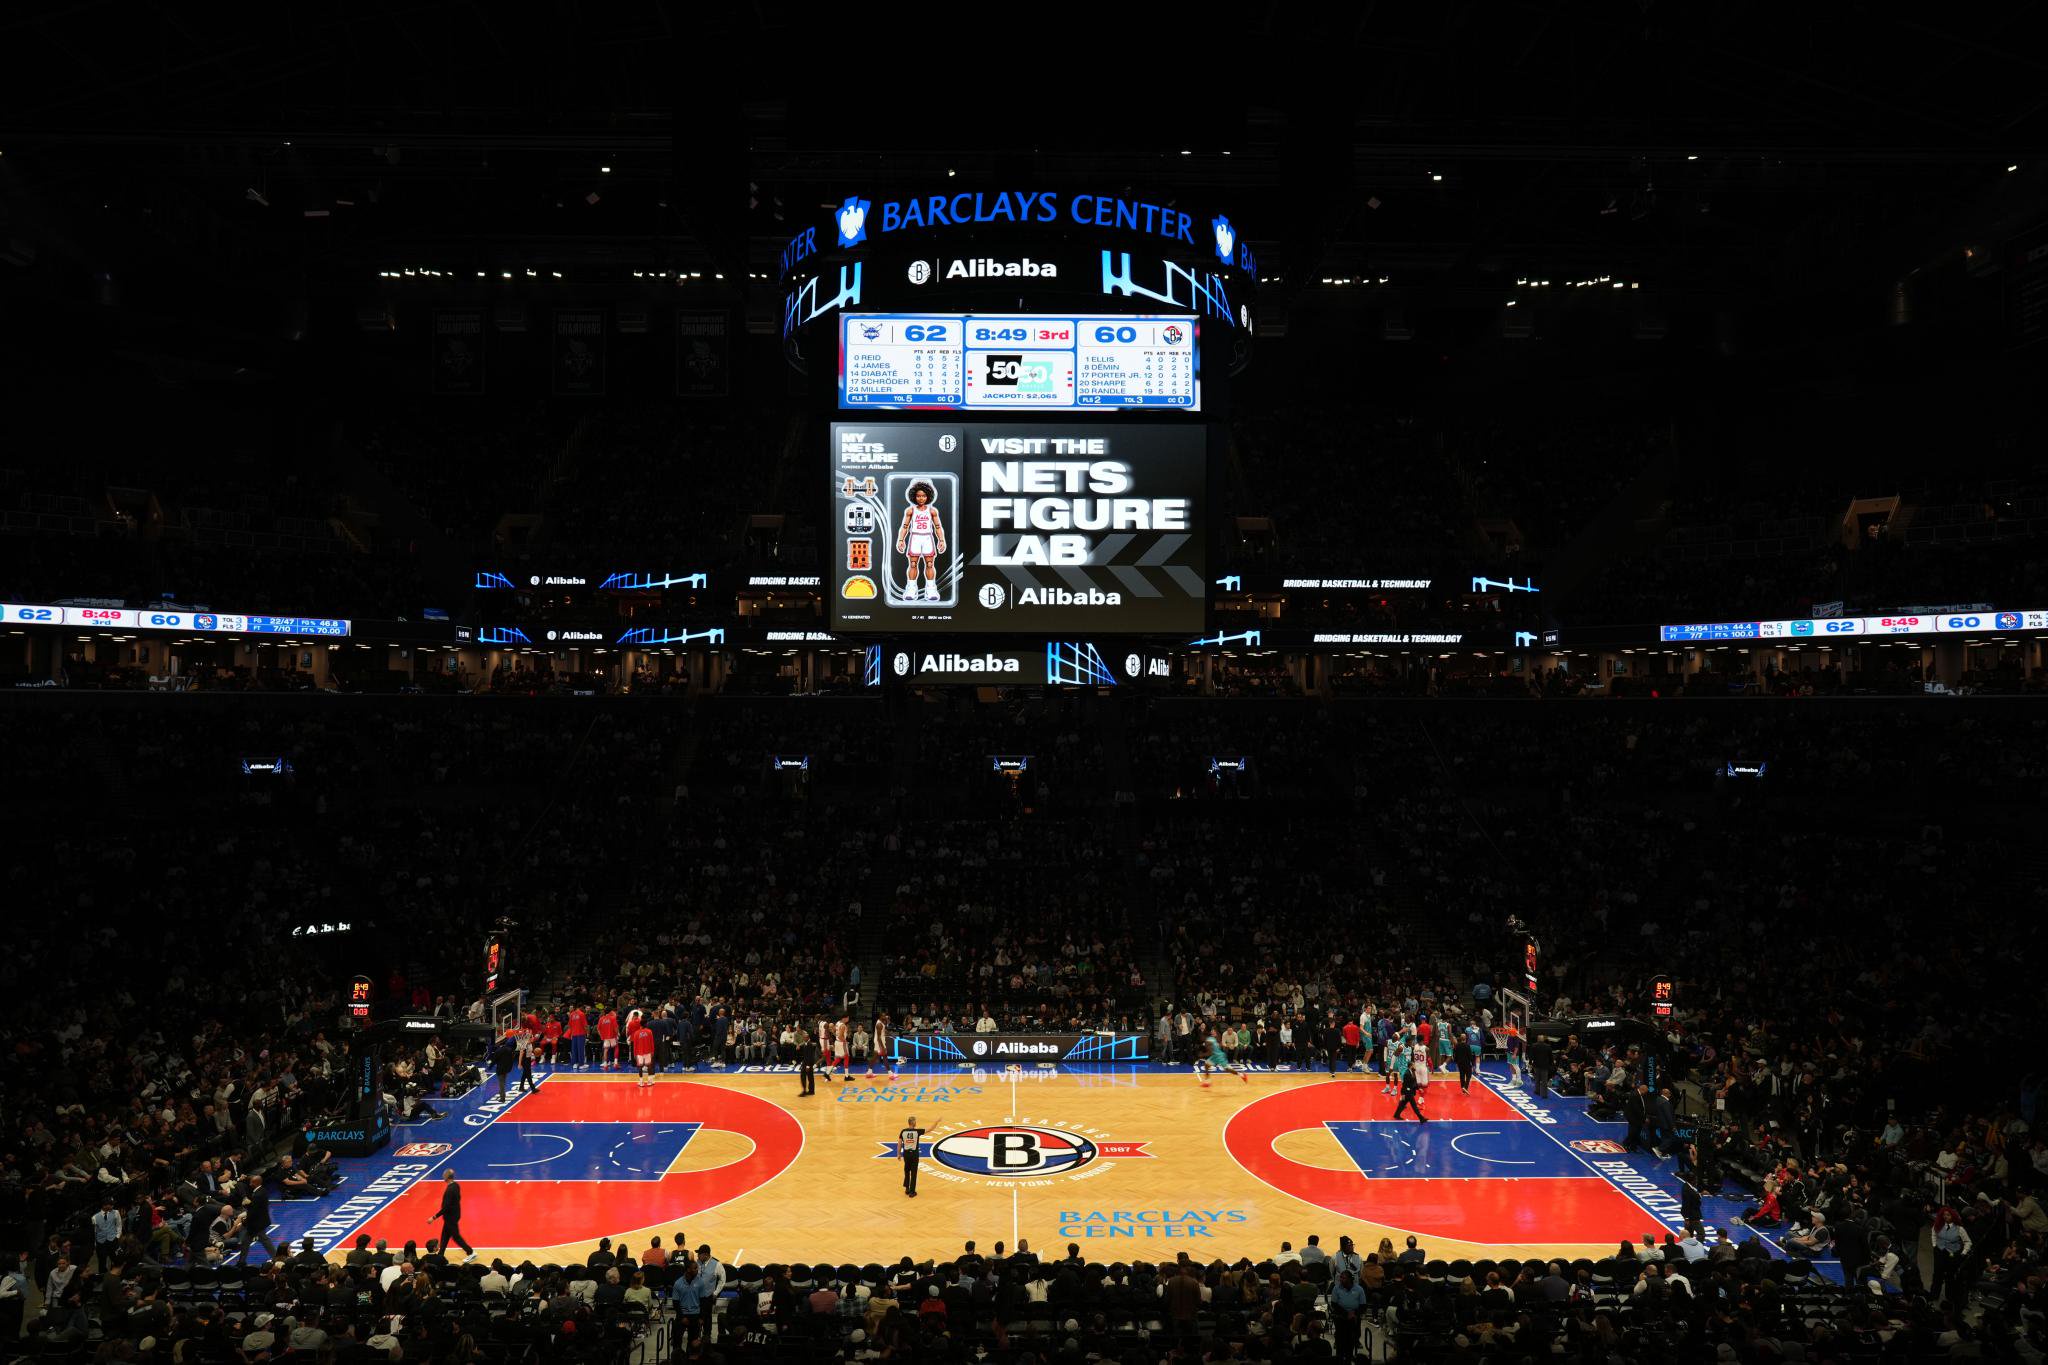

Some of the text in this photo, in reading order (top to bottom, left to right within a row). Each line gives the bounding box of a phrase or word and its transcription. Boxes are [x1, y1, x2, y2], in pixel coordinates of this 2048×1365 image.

[882, 192, 1195, 244] BARCLAYS CENTER
[946, 258, 1056, 278] Alibaba
[905, 325, 946, 342] 62
[976, 328, 1069, 340] 8:49 3rd
[1095, 326, 1136, 343] 60
[992, 361, 1020, 379] 50
[842, 433, 866, 442] MY
[842, 443, 885, 453] NETS
[980, 438, 1104, 454] VISIT THE
[842, 453, 898, 462] FIGURE
[980, 462, 1129, 494] NETS
[980, 498, 1186, 530] FIGURE
[980, 534, 1088, 566] LAB
[545, 577, 586, 585] Alibaba
[749, 577, 820, 585] BRIDGING BASKET
[1283, 580, 1431, 588] BRIDGING BASKETBALL & TECHNOLOGY
[1018, 587, 1121, 606] Alibaba
[18, 608, 52, 620] 62
[82, 610, 121, 619] 8:49
[151, 614, 180, 626] 60
[1826, 622, 1854, 632] 62
[1881, 618, 1919, 627] 8:49
[1948, 617, 1980, 628] 60
[766, 632, 804, 640] BRIDGING
[1314, 634, 1351, 642] BRIDGING
[1411, 634, 1462, 643] TECHNOLOGY
[920, 654, 1019, 672] Alibaba
[353, 990, 366, 999] 24
[1656, 990, 1668, 998] 24
[996, 1042, 1058, 1054] Alibaba
[1414, 1053, 1424, 1062] 30
[921, 1117, 1111, 1140] SIXTY SEASONS
[317, 1130, 365, 1140] BARCLAYS
[993, 1134, 1040, 1168] B
[361, 1164, 428, 1192] NETS
[1019, 1179, 1055, 1187] YORK
[1060, 1210, 1247, 1223] BARCLAYS
[1058, 1225, 1215, 1237] CENTER
